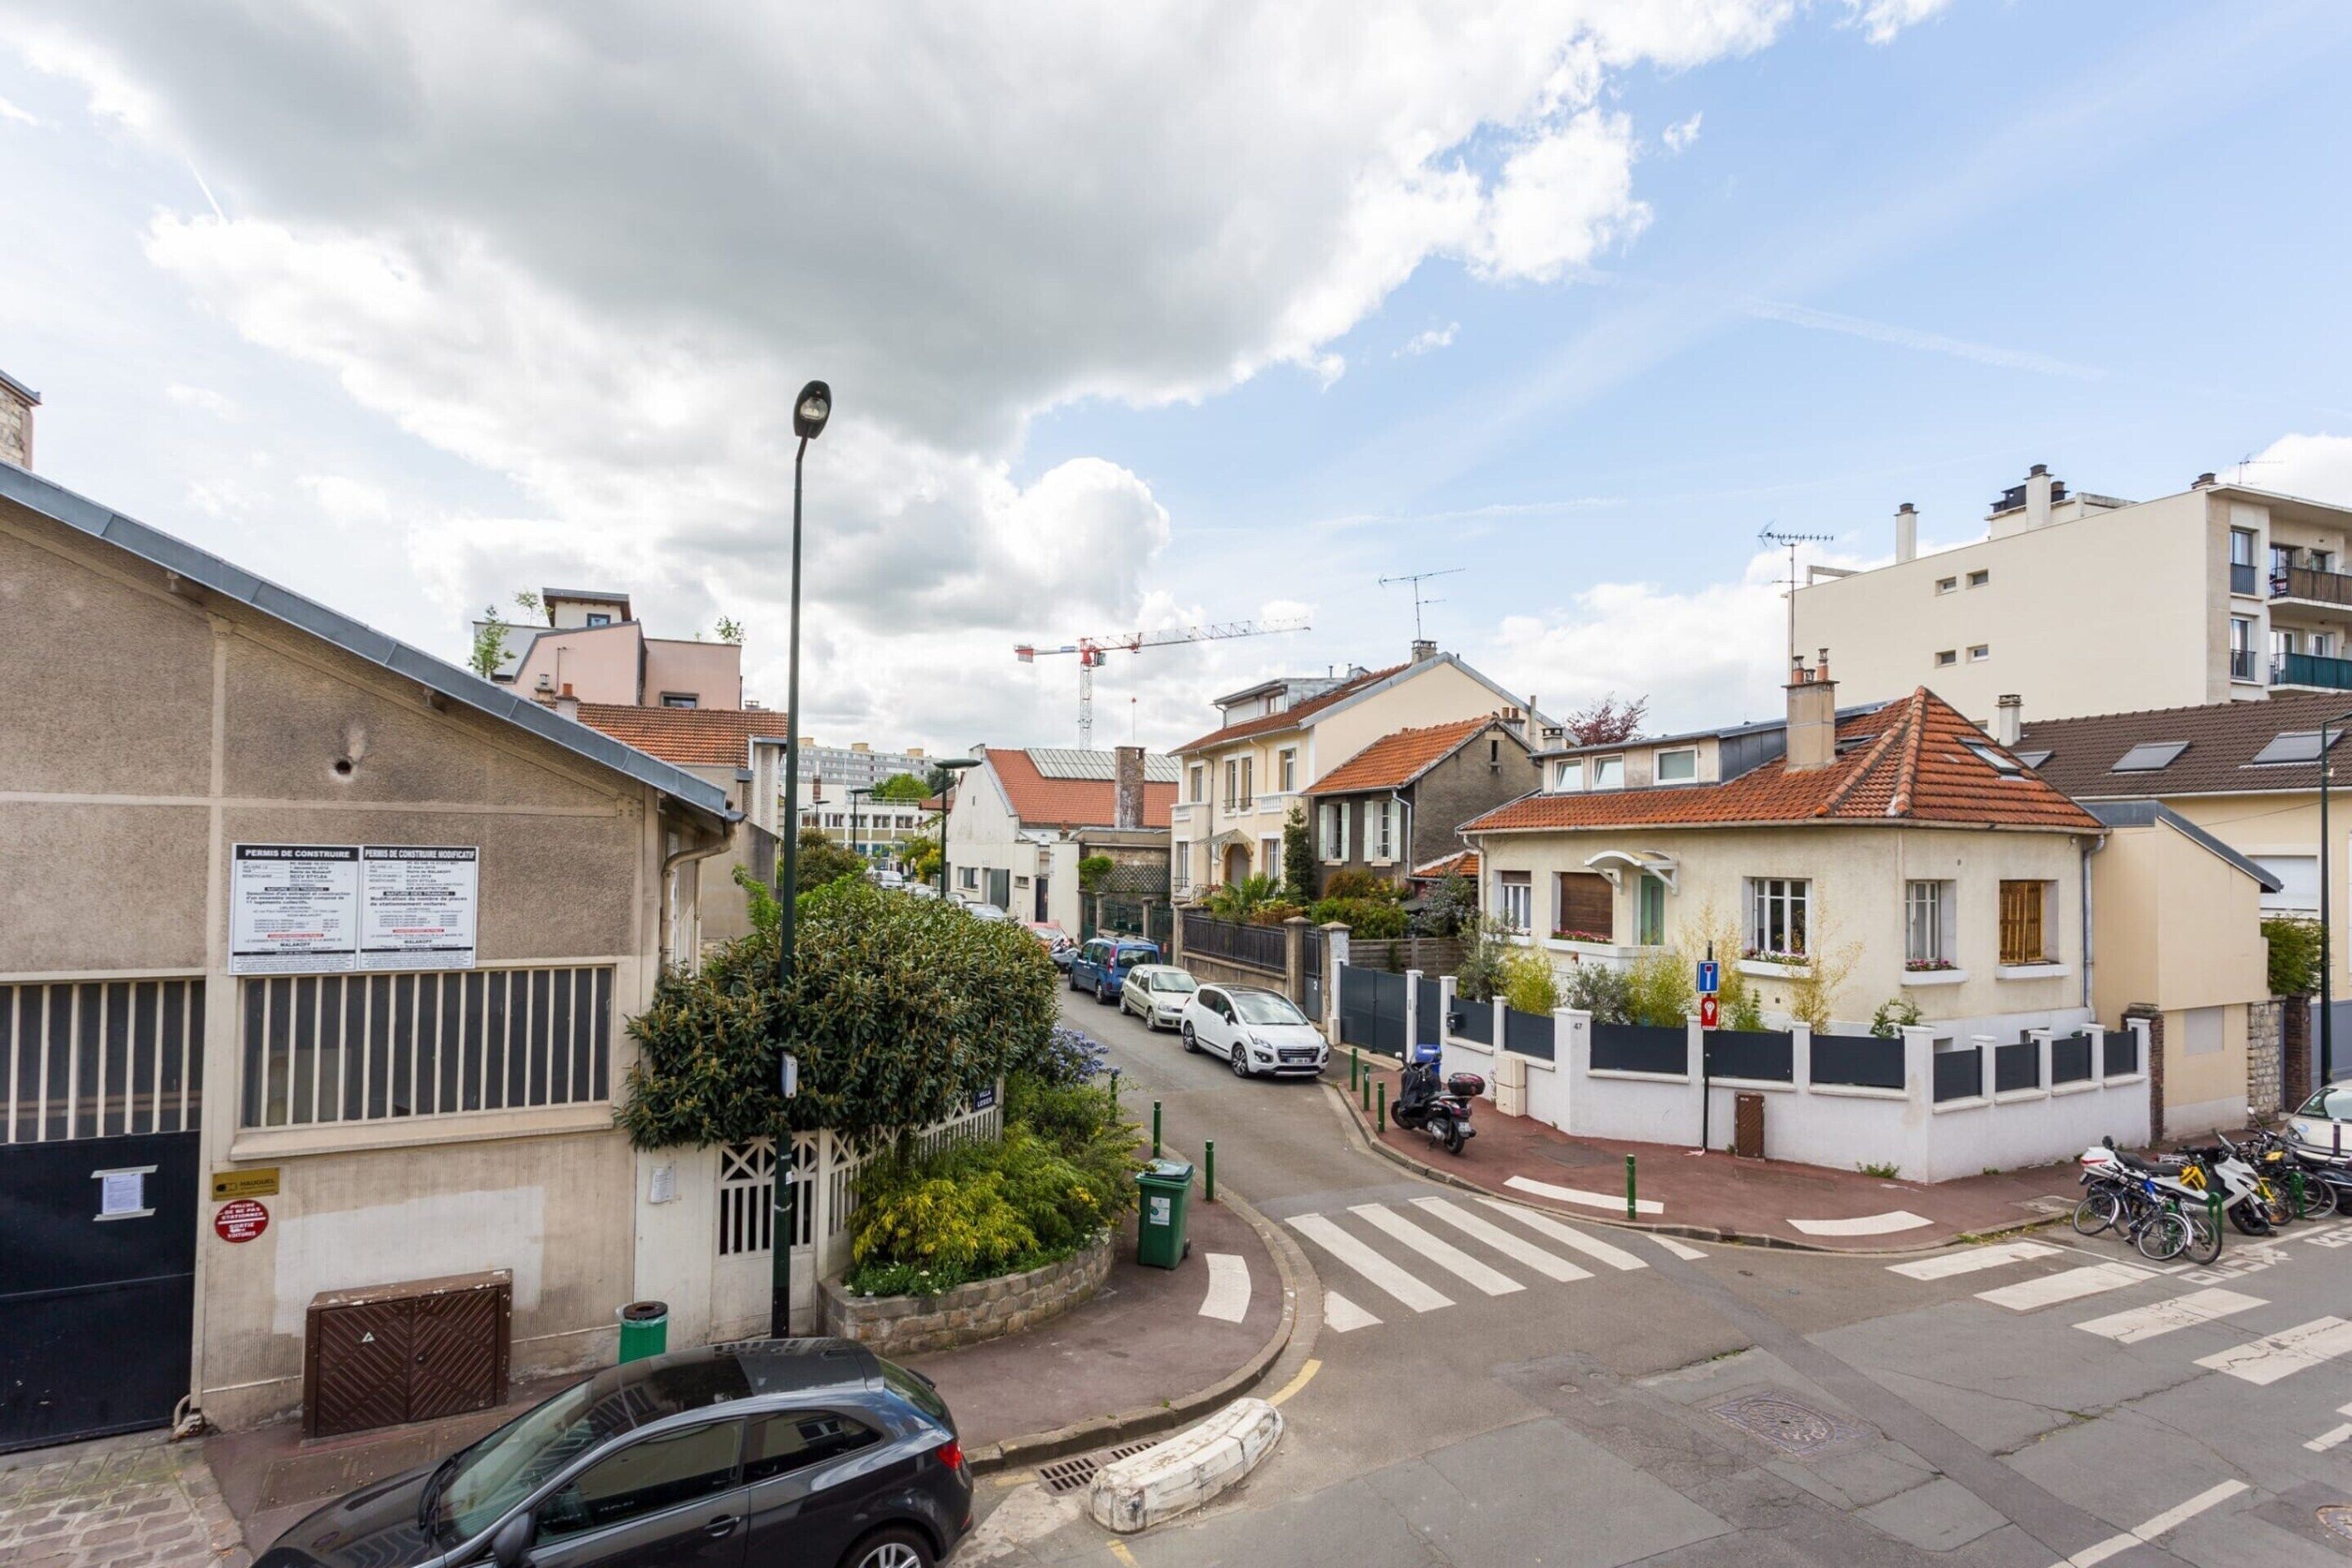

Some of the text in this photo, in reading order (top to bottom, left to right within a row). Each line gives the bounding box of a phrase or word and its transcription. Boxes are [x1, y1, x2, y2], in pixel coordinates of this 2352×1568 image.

[295, 850, 350, 858] CONSTRUIRE
[365, 849, 475, 858] PERMIS DE CONSTRUIRE MODIFICATIF
[1313, 980, 1318, 991] 2
[221, 1212, 263, 1220] STATIONNER
